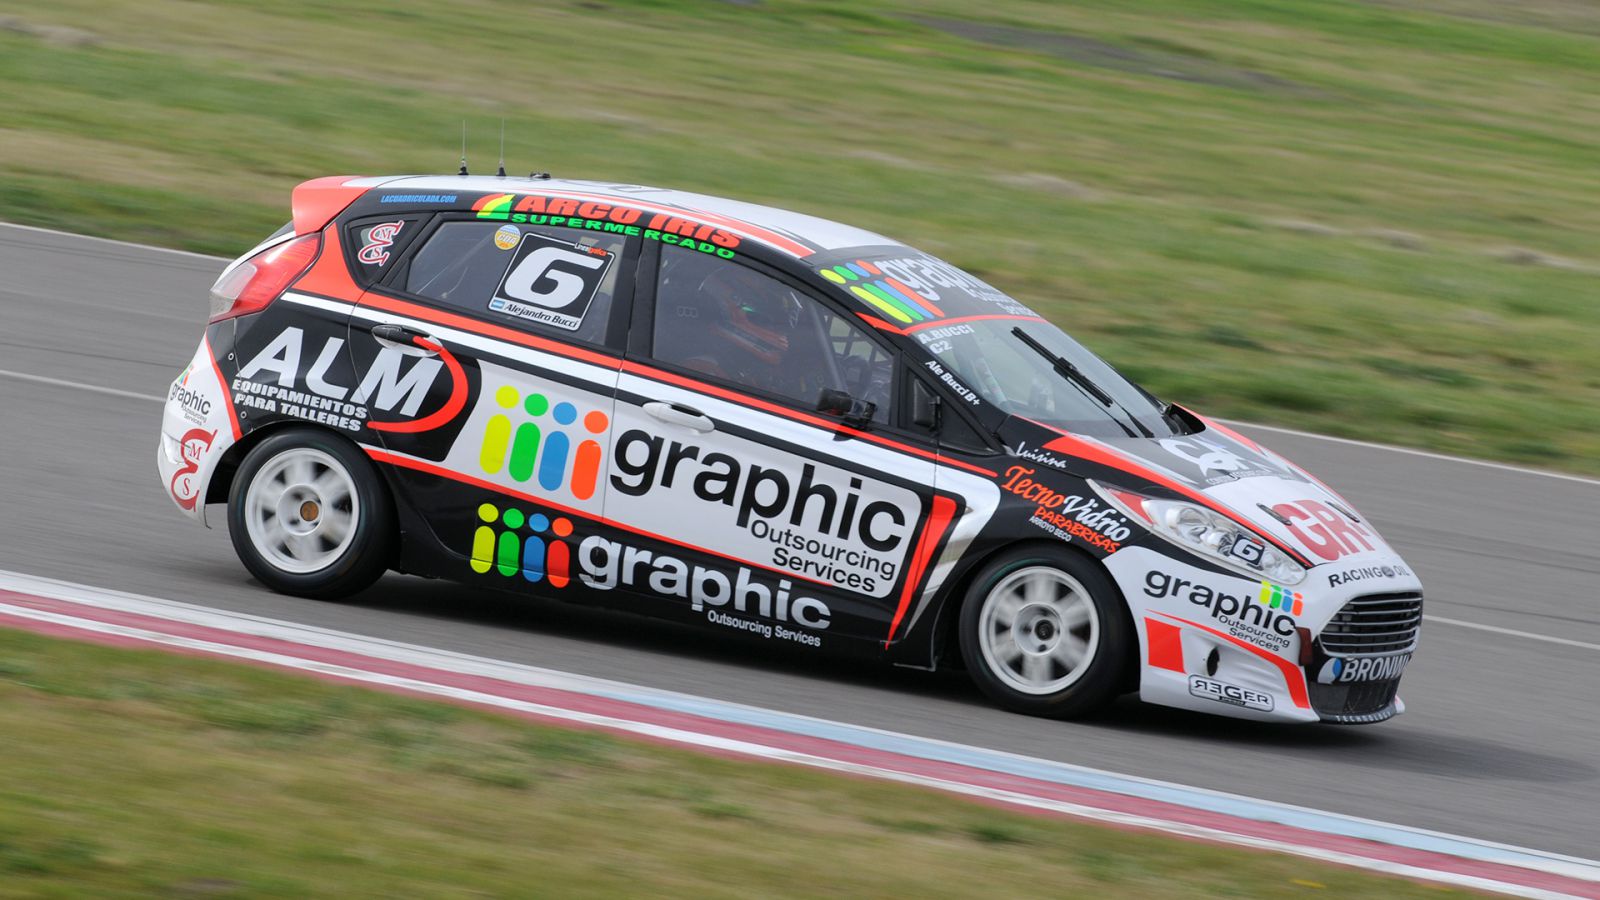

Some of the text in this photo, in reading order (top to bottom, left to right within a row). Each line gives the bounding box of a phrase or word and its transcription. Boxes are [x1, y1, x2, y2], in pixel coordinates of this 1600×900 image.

[512, 213, 736, 260] SUPERMERCADO
[514, 195, 743, 249] ARCO IRIS
[505, 247, 605, 308] 6
[504, 304, 579, 328] Alejandro Bucci
[918, 324, 975, 344] A.BUCCI
[929, 340, 953, 354] C2
[235, 326, 444, 417] ALM
[925, 360, 980, 406] Ale Bucci B+
[232, 379, 368, 419] EQUIPAMIENTOS
[234, 393, 361, 432] PARA TALLERES
[610, 429, 906, 553] graphic
[751, 519, 896, 581] Outsourcing
[1029, 516, 1072, 542] ARROYO SECO
[1034, 506, 1120, 553] PARABRISAS
[1232, 538, 1264, 561] 6
[578, 535, 831, 630] graphic
[772, 547, 876, 593] Services
[1328, 567, 1381, 588] RACING
[1143, 570, 1296, 636] graphic
[708, 610, 821, 647] Outsourcing Services
[1218, 614, 1291, 648] Outsourcing
[1229, 627, 1280, 652] Services
